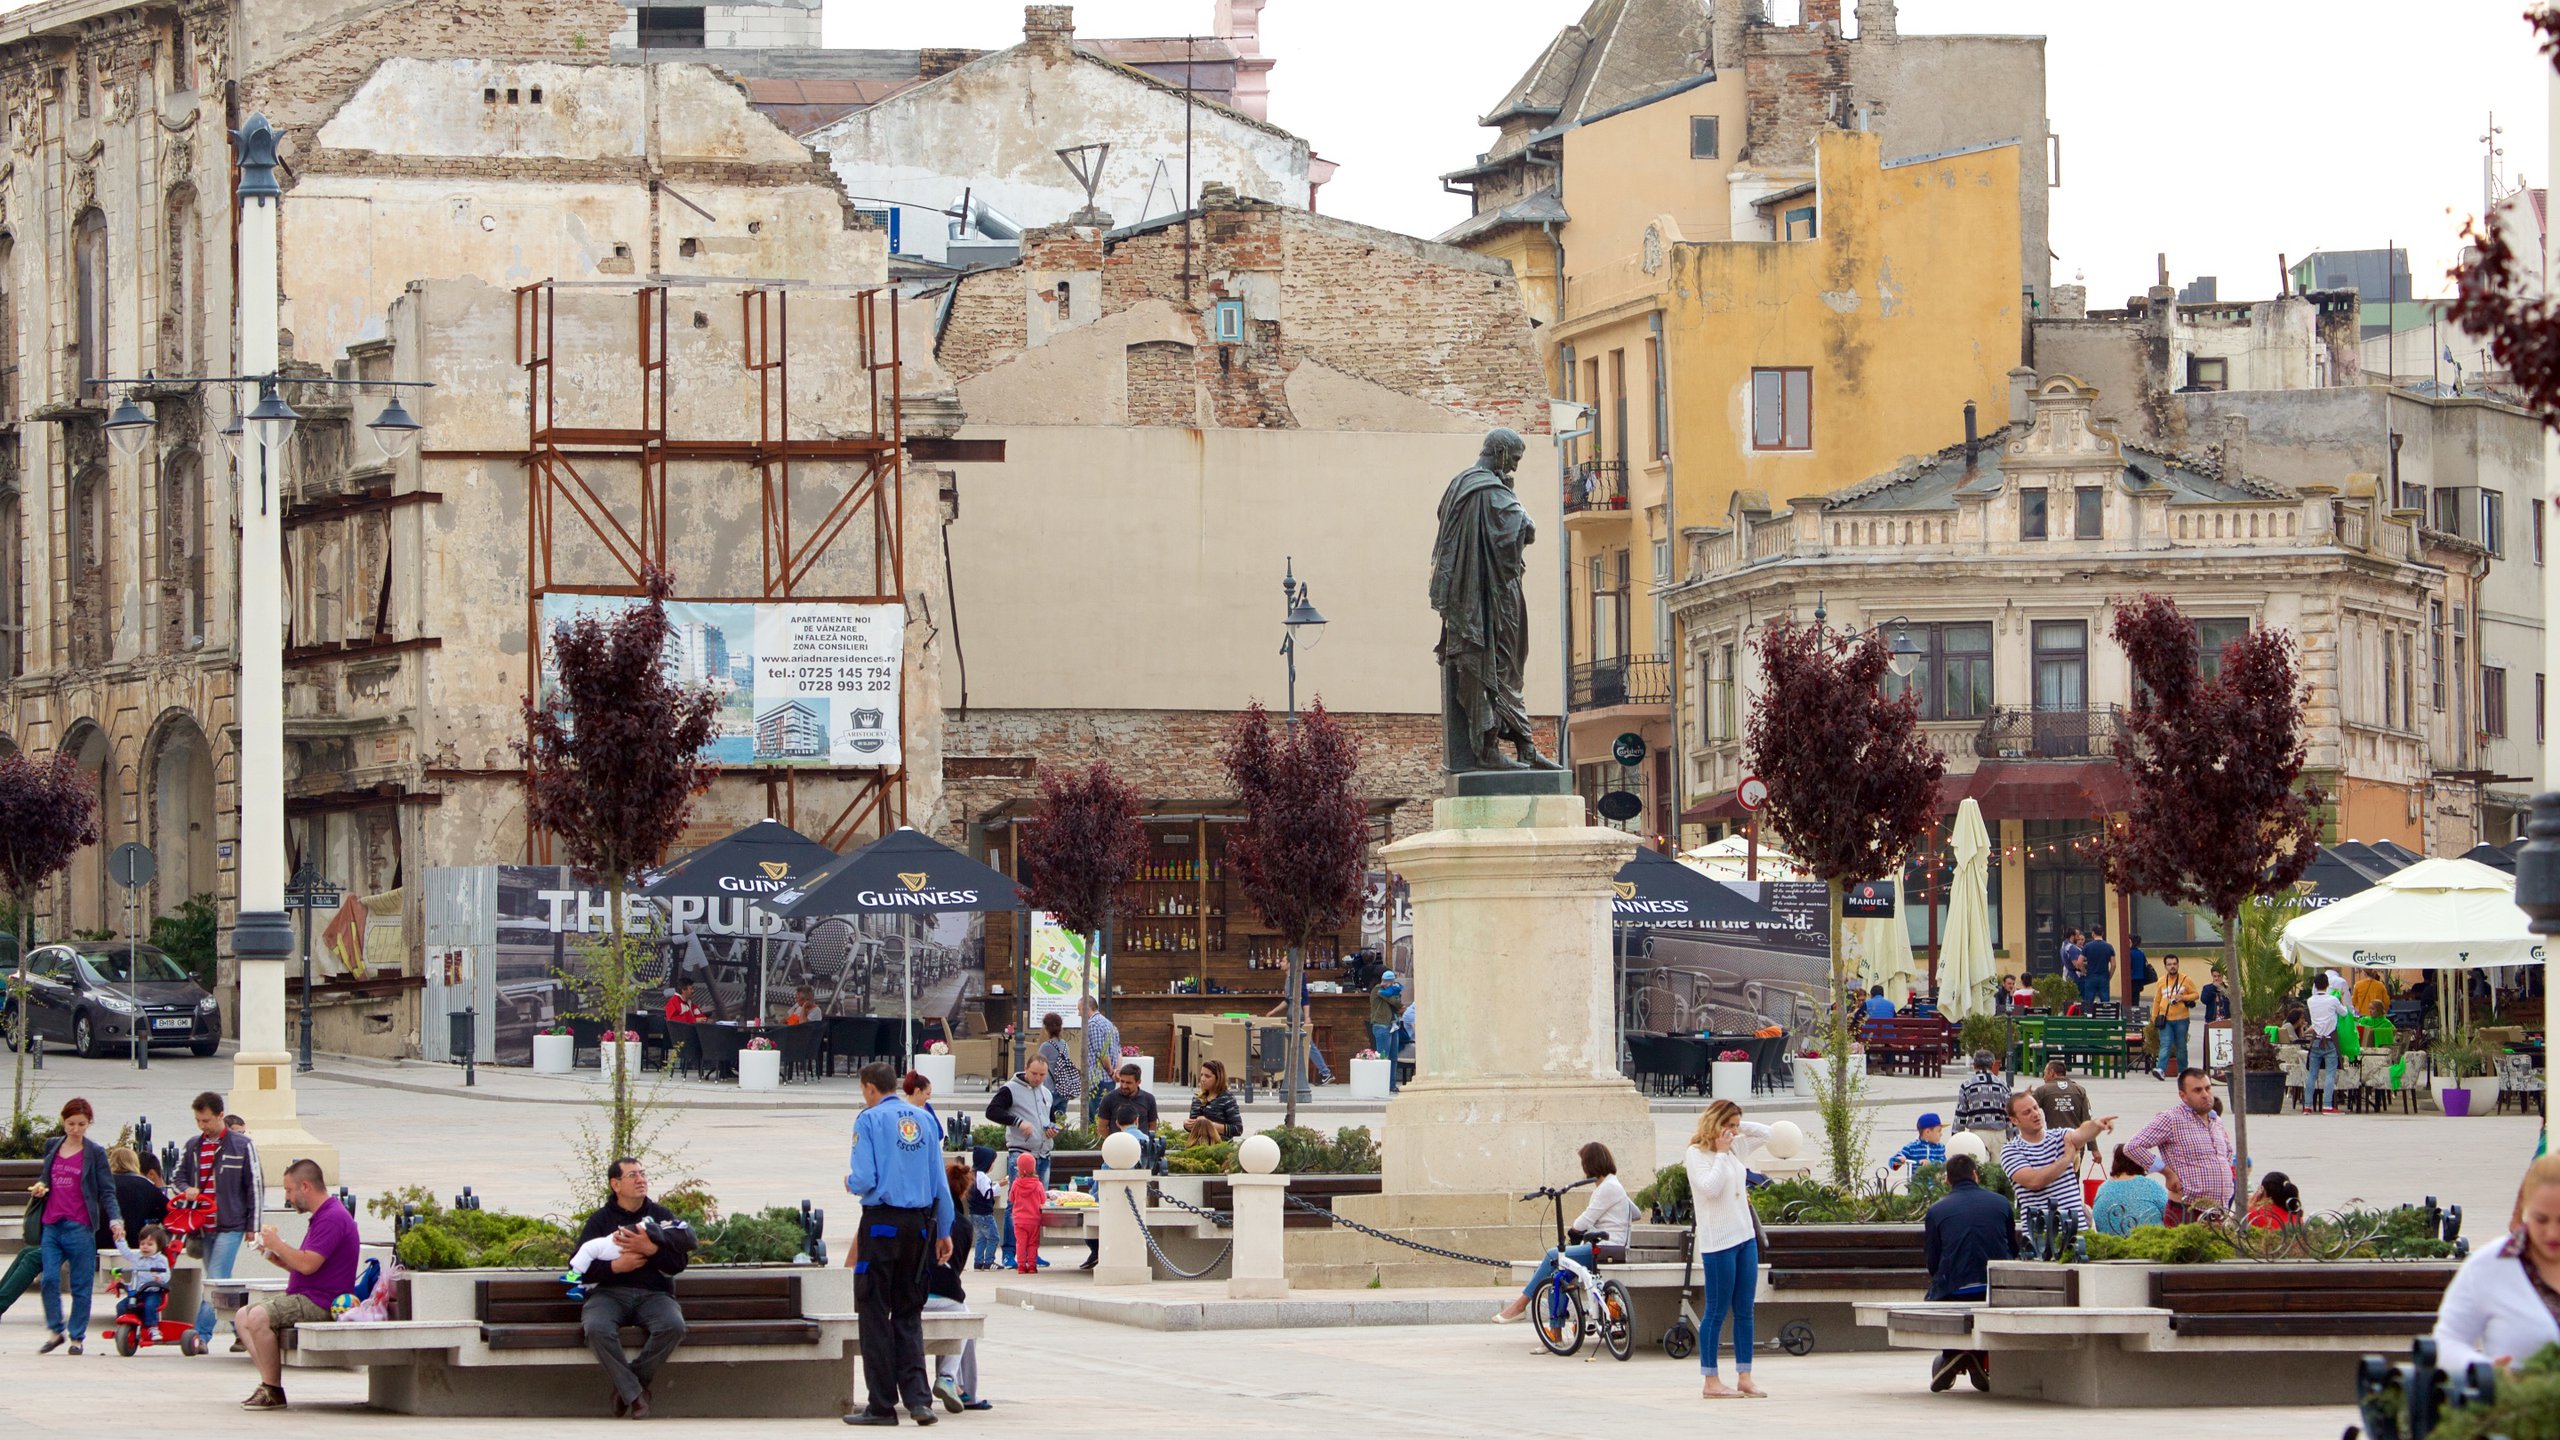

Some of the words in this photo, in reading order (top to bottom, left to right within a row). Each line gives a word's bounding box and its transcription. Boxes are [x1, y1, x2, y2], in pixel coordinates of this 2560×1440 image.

[790, 616, 852, 624] APARTAMENTE
[855, 616, 871, 624] NOI
[840, 634, 867, 643] NORD,
[793, 643, 816, 651] ZONA
[818, 643, 868, 651] CONSILIERI
[761, 654, 896, 663] www.ariadnaresidences.ro
[768, 668, 795, 679] tel.:
[799, 667, 833, 679] 0725
[837, 667, 863, 679] 145
[867, 667, 891, 679] 794
[798, 680, 833, 692] 0728
[837, 680, 863, 692] 993
[867, 680, 891, 692] 202
[857, 890, 979, 906] GUINNESS
[1848, 897, 1889, 906] MANUEL
[537, 890, 652, 934] THE
[2352, 950, 2396, 964] Carlsberg
[896, 1138, 927, 1152] ESCORT
